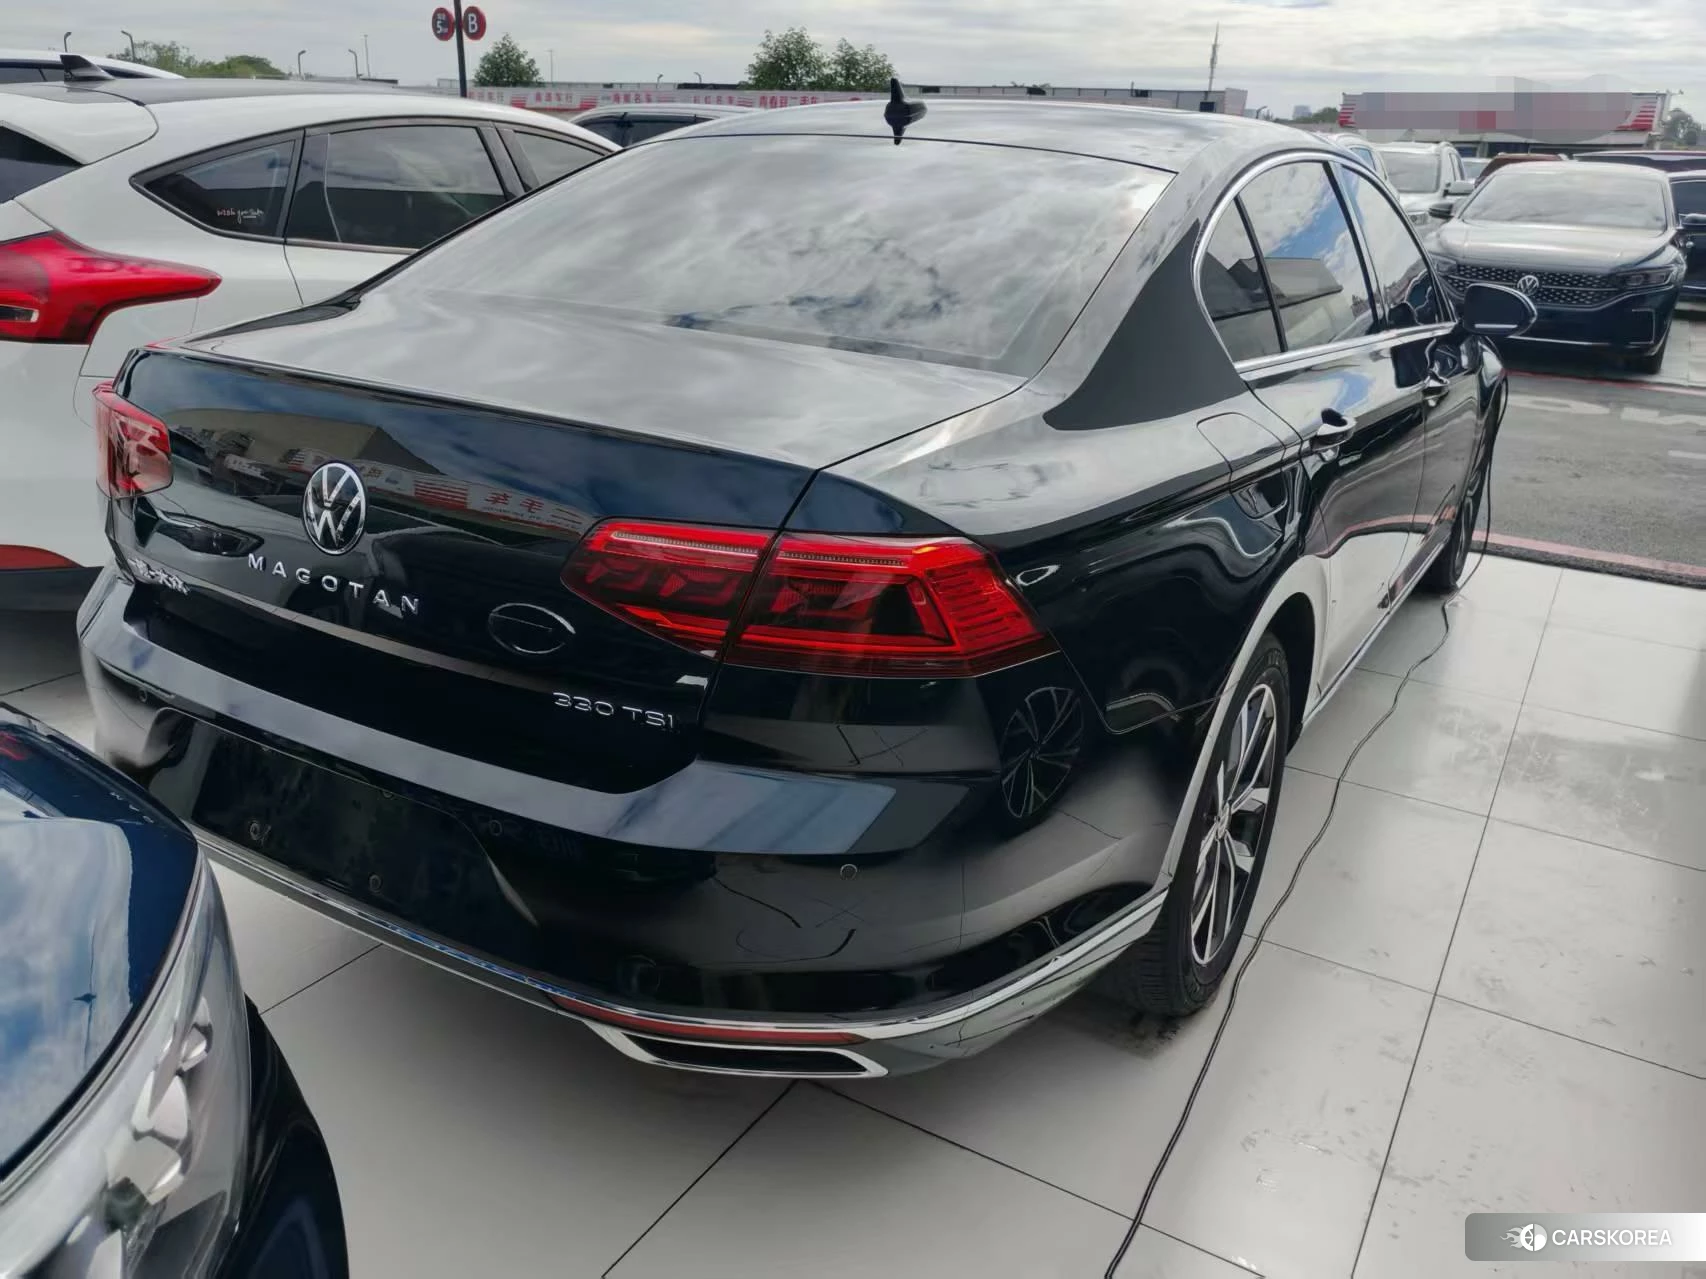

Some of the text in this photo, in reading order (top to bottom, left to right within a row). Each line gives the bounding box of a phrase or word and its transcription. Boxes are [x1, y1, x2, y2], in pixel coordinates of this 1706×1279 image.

[468, 13, 478, 33] B
[248, 552, 420, 615] MAGOTAN
[552, 692, 674, 729] 330 TSI
